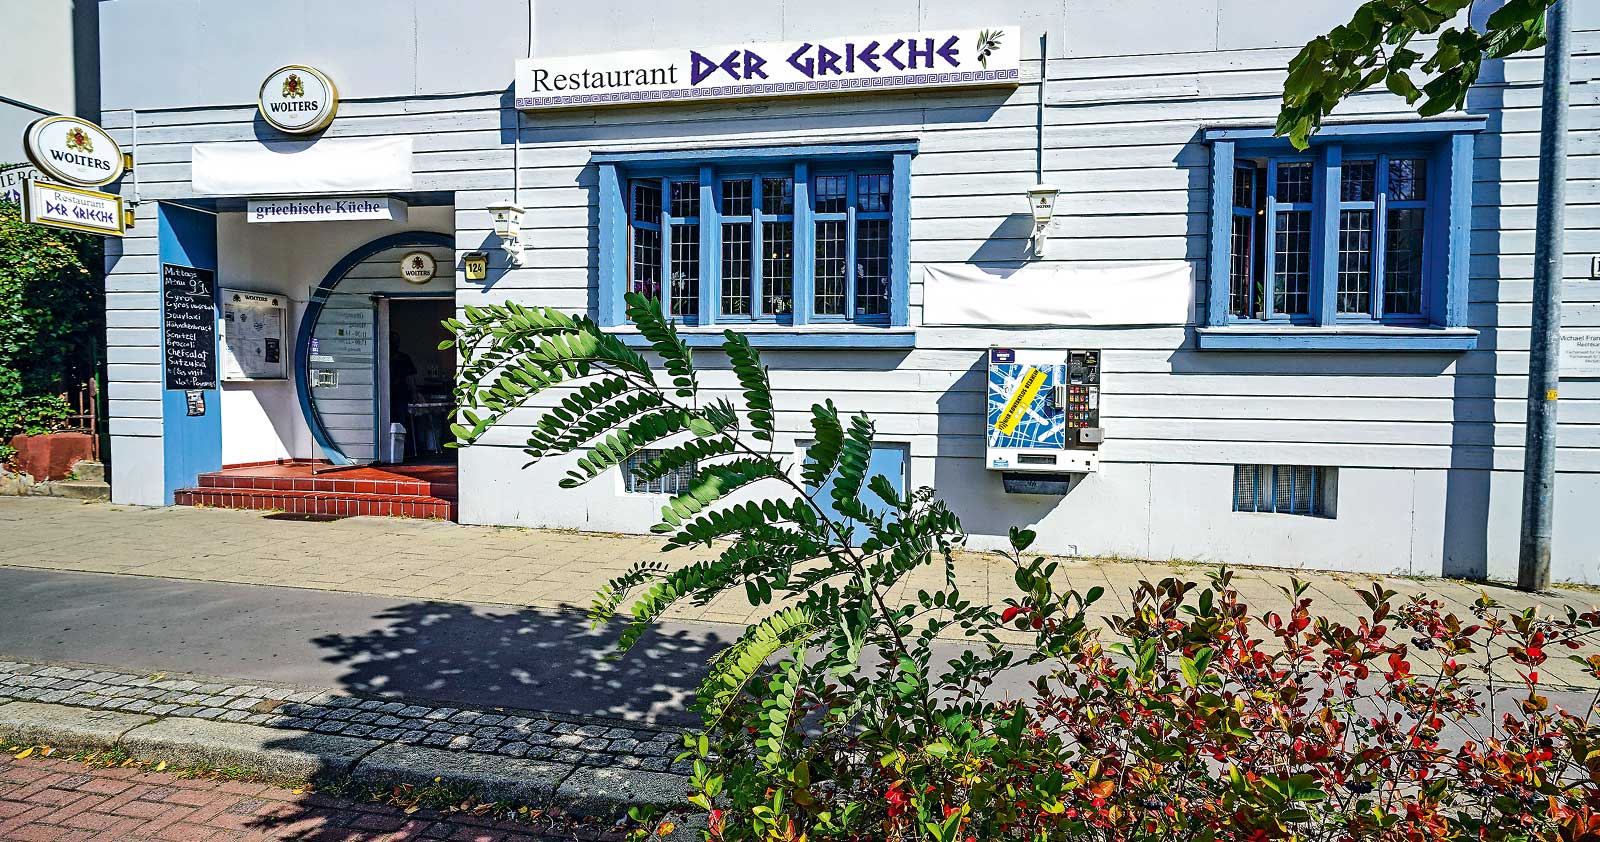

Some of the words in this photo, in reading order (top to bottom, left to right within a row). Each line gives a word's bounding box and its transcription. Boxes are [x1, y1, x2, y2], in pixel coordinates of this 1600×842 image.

[531, 63, 679, 93] Restaurant
[690, 49, 769, 87] DER
[786, 35, 960, 79] GRIECHE
[270, 100, 318, 113] WOLTERS
[50, 149, 110, 170] WOLTERS
[54, 191, 104, 209] Restaurant
[256, 201, 331, 219] griechische
[335, 200, 380, 213] Küche
[46, 200, 68, 217] DER
[72, 205, 114, 224] GRIECHE
[468, 263, 482, 273] 124
